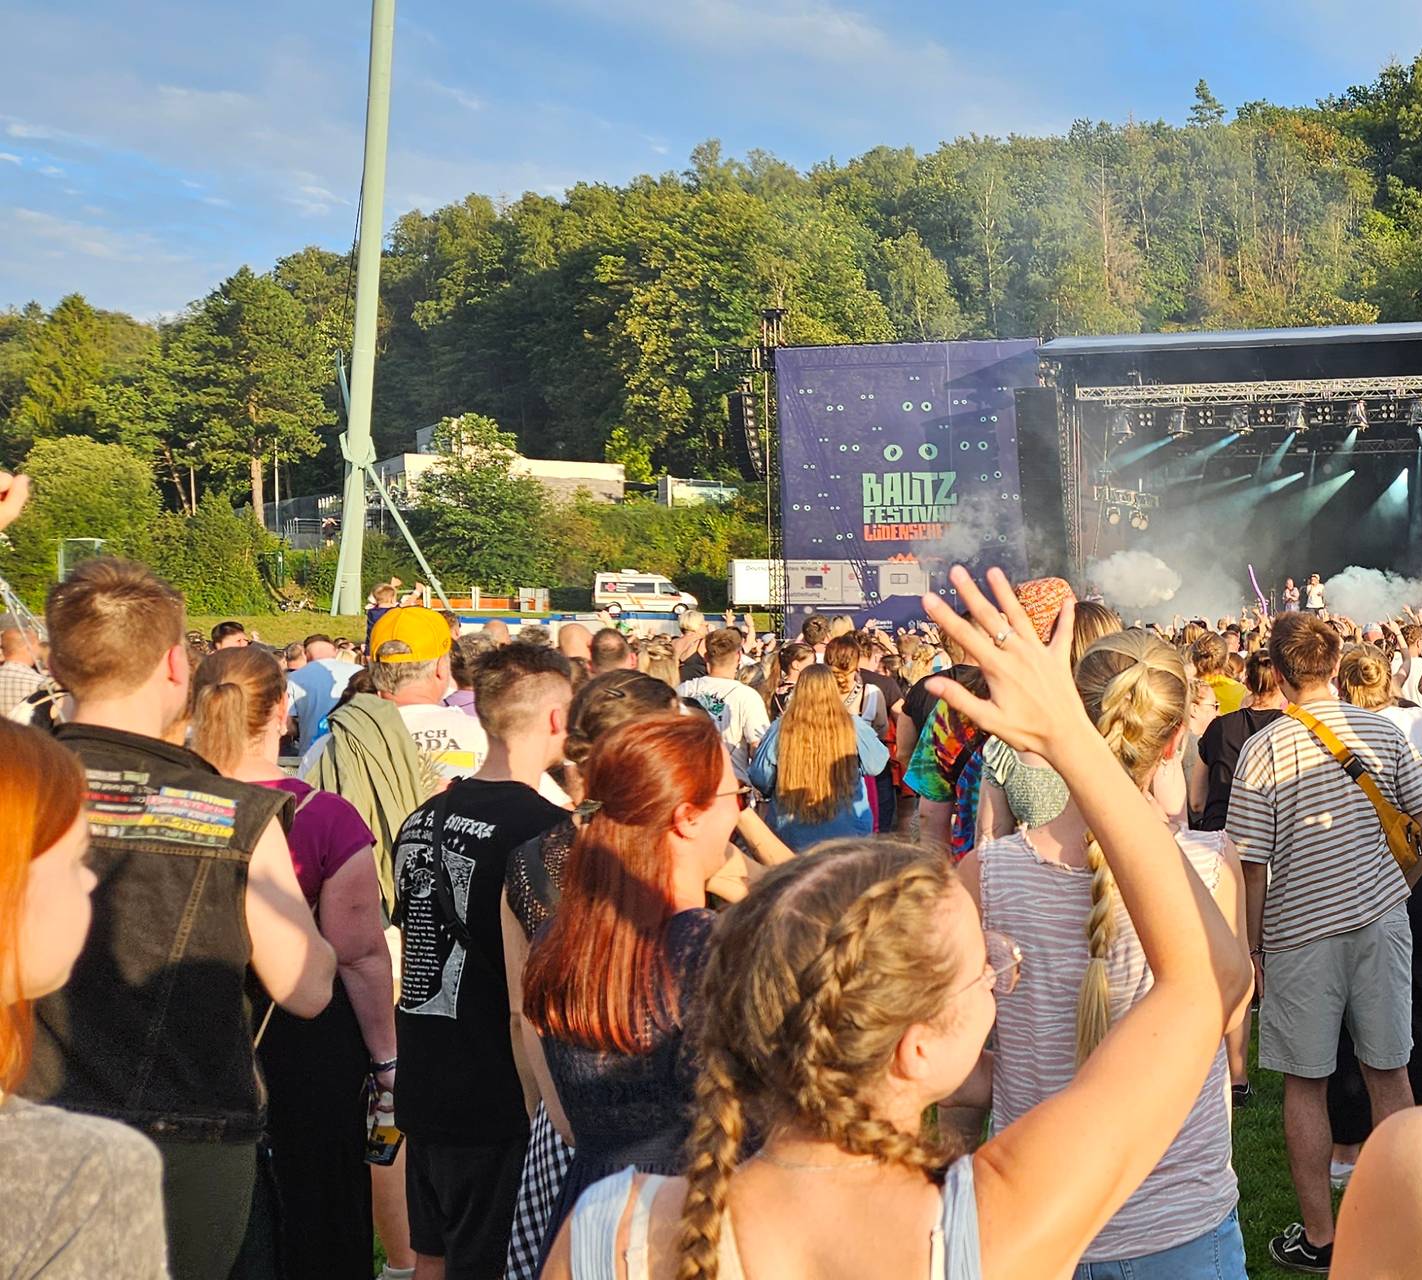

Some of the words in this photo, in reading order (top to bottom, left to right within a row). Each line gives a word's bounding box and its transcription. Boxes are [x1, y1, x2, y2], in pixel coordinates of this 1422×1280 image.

[862, 471, 957, 506] BAUTZ
[863, 524, 945, 541] LÜDENSCHE
[412, 729, 448, 740] TCH
